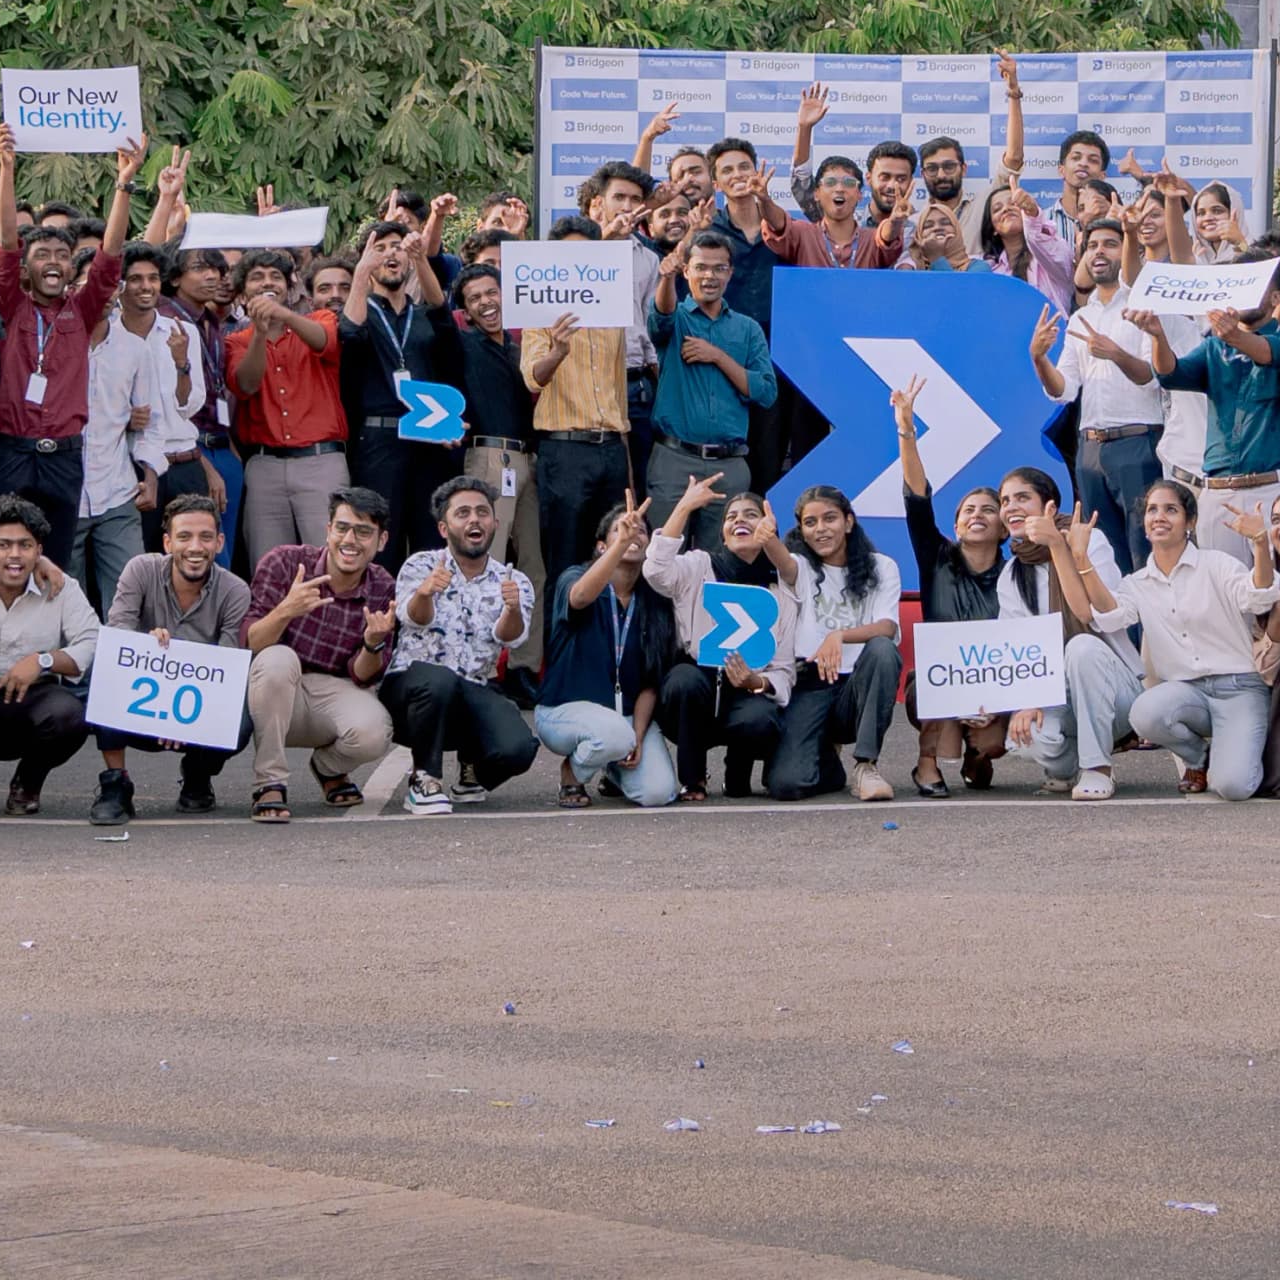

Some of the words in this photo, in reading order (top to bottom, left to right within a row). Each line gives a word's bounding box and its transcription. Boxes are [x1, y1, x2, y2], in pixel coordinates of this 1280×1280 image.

[577, 56, 624, 68] Bridgeon
[753, 59, 800, 71] Bridgeon
[928, 62, 976, 73] Bridgeon
[1105, 60, 1152, 72] Bridgeon
[19, 86, 60, 104] Our
[67, 87, 118, 105] New
[665, 90, 712, 102] Bridgeon
[841, 92, 888, 104] Bridgeon
[1022, 93, 1064, 105] ridgeon
[1192, 90, 1239, 102] Bridgeon
[19, 106, 127, 133] Identity.
[577, 122, 624, 134] Bridgeon
[752, 122, 798, 135] Bridgeon
[928, 125, 976, 136] Bridgeon
[1105, 124, 1151, 136] Bridgeon
[1023, 156, 1060, 168] ridgeo
[1192, 156, 1238, 167] Bridgeon
[515, 264, 569, 282] Code
[575, 264, 619, 282] Your
[1152, 275, 1208, 289] Code
[1216, 276, 1257, 288] Your
[515, 285, 601, 304] Future.
[1145, 285, 1232, 302] Future.
[959, 642, 1041, 667] We've
[117, 646, 225, 683] Bridgeon
[927, 655, 1054, 687] Changed.
[127, 677, 203, 725] 2.0
